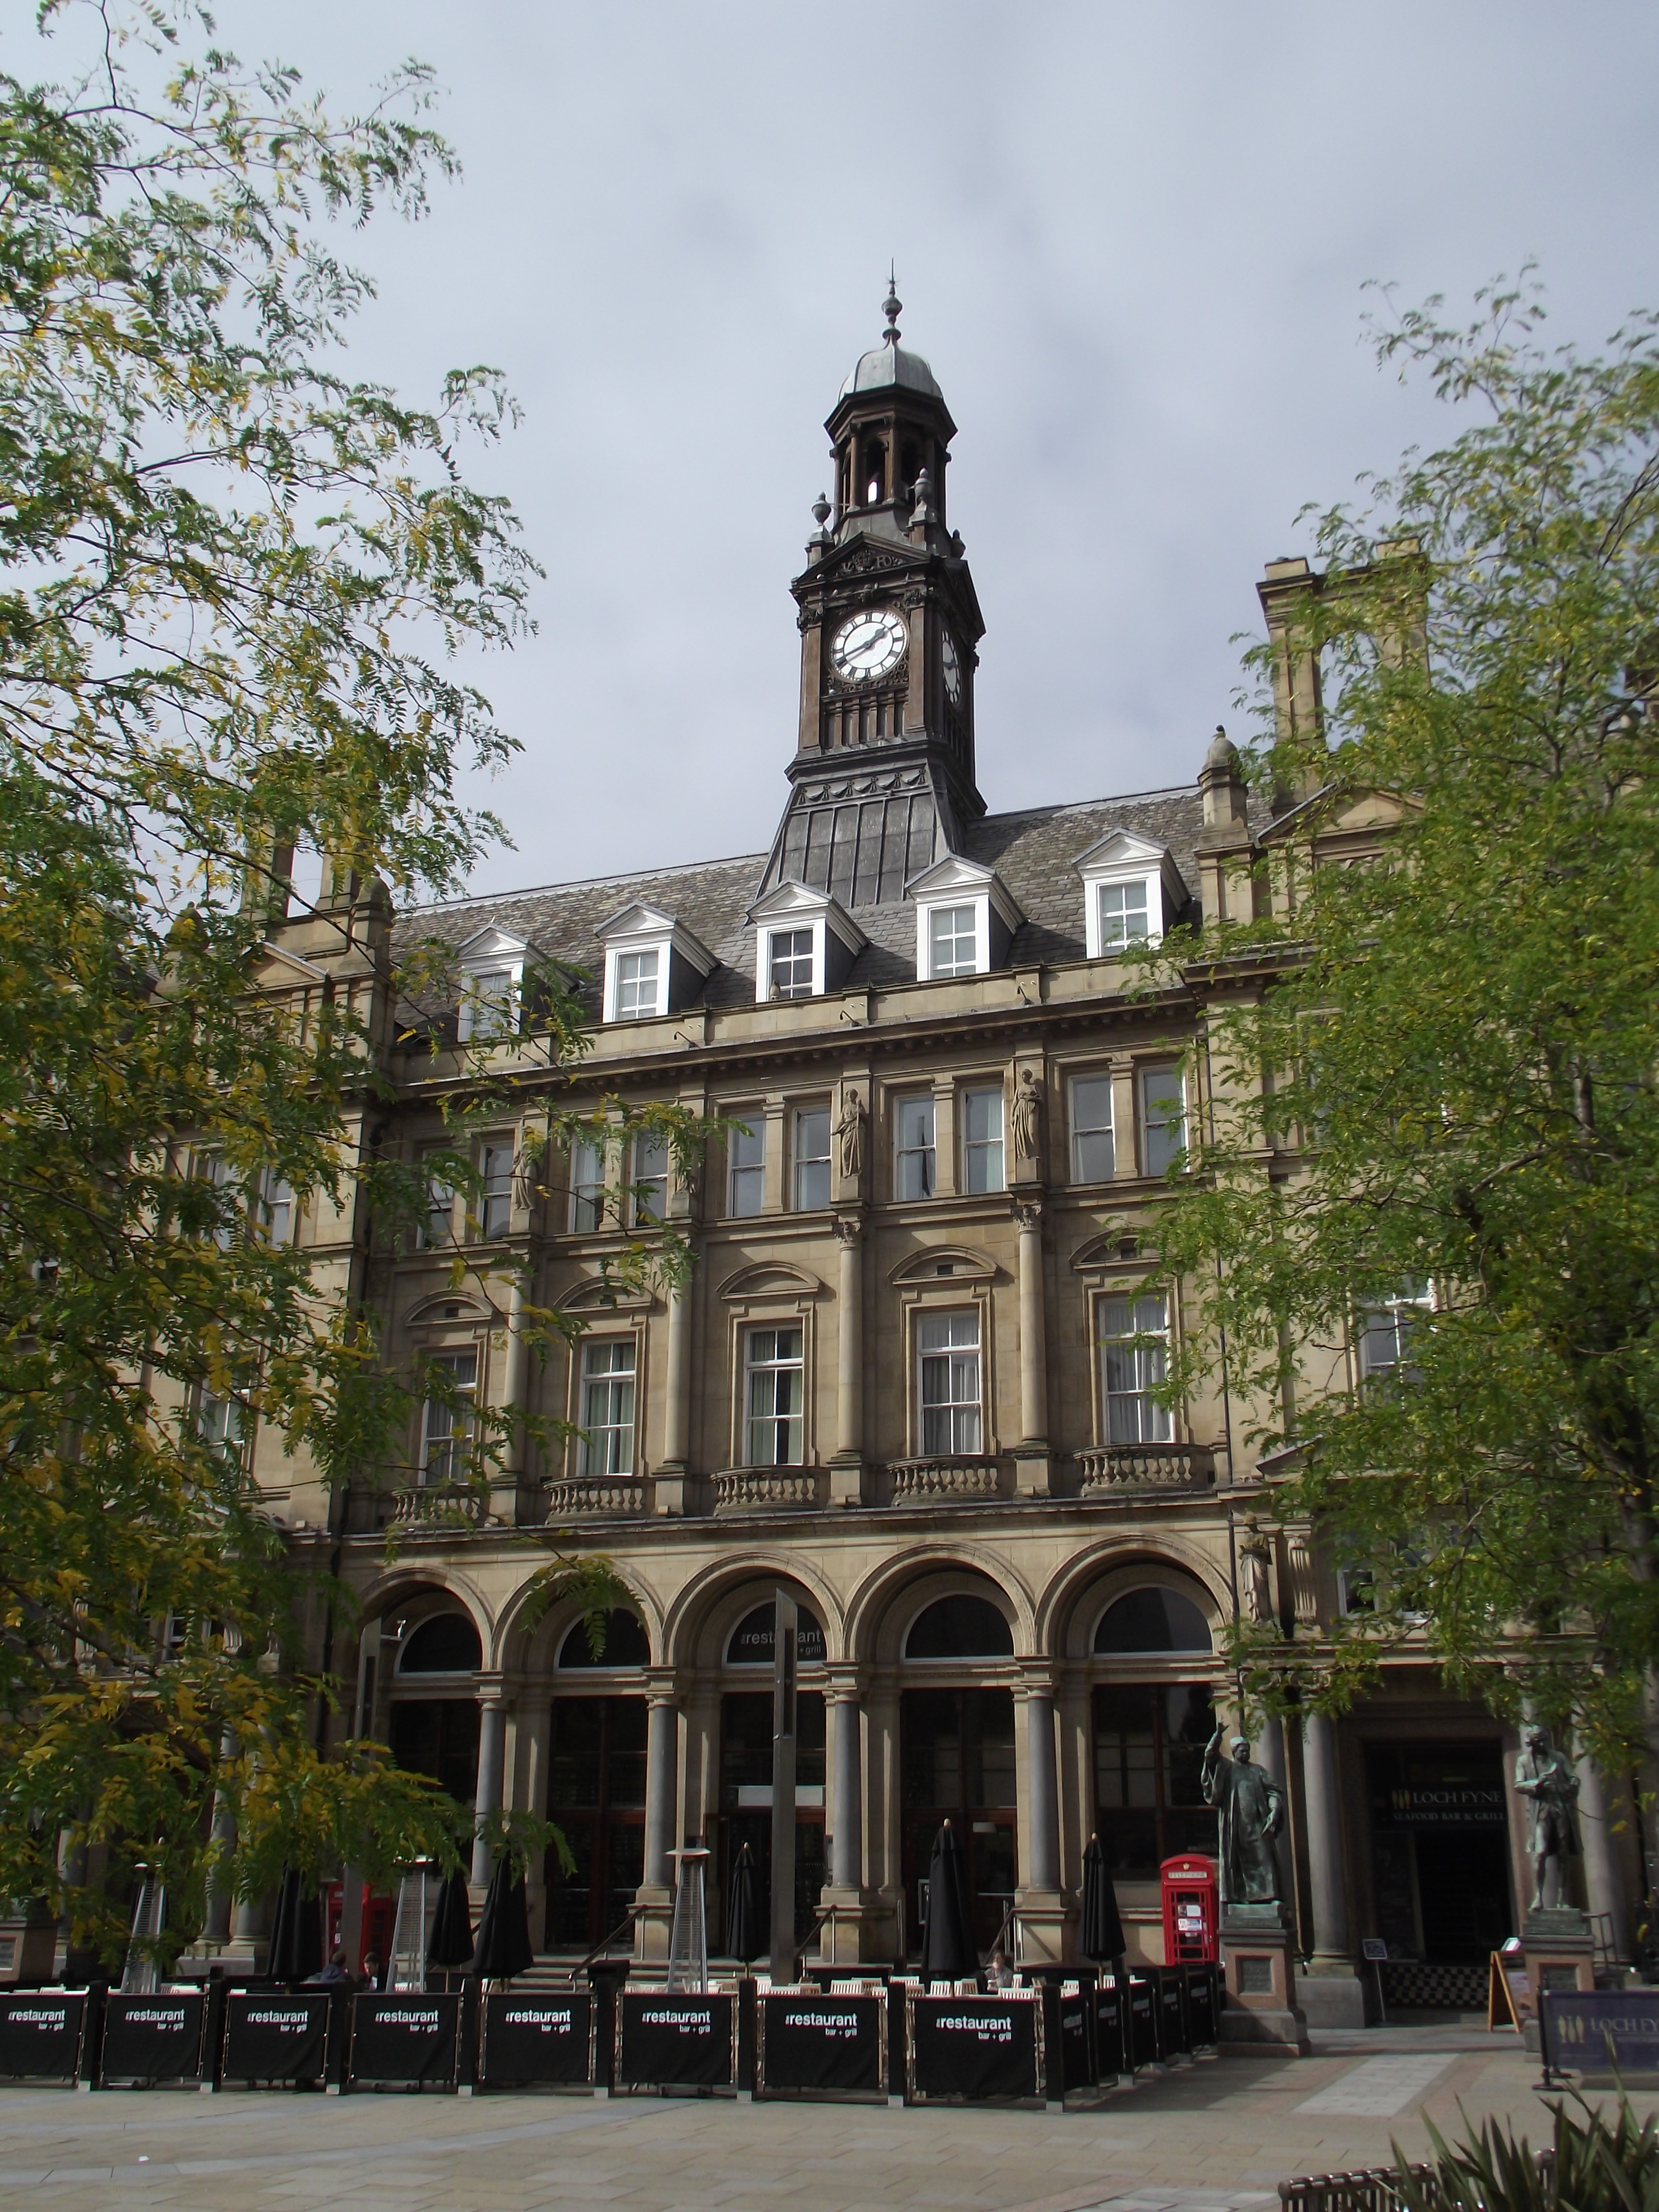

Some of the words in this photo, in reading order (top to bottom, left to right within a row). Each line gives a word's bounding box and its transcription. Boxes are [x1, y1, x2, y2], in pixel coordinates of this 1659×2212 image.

[805, 1646, 821, 1655] grill
[1413, 1792, 1457, 1803] LOCH
[1461, 1791, 1503, 1803] FYNE
[1394, 1812, 1438, 1820] SEAFOOD
[1442, 1812, 1461, 1820] BAR
[1464, 1812, 1472, 1820] &
[1475, 1812, 1505, 1820] GRILL
[11, 2009, 65, 2021] restaurant
[129, 2008, 185, 2021] restaurant
[251, 2010, 308, 2022] restaurant
[379, 2010, 438, 2022] restaurant
[510, 2009, 571, 2022] restaurant
[646, 2010, 710, 2023] restaurant
[790, 2012, 857, 2026] restaurant
[427, 2023, 438, 2033] grill
[559, 2023, 571, 2034] grill
[940, 2015, 1012, 2030] restaurant
[1590, 2018, 1637, 2031] LOCH
[679, 2024, 690, 2032] bar
[698, 2024, 710, 2035] grill
[825, 2027, 836, 2036] bar
[844, 2028, 857, 2038] grill
[978, 2031, 990, 2040] bar
[999, 2031, 1011, 2042] grill
